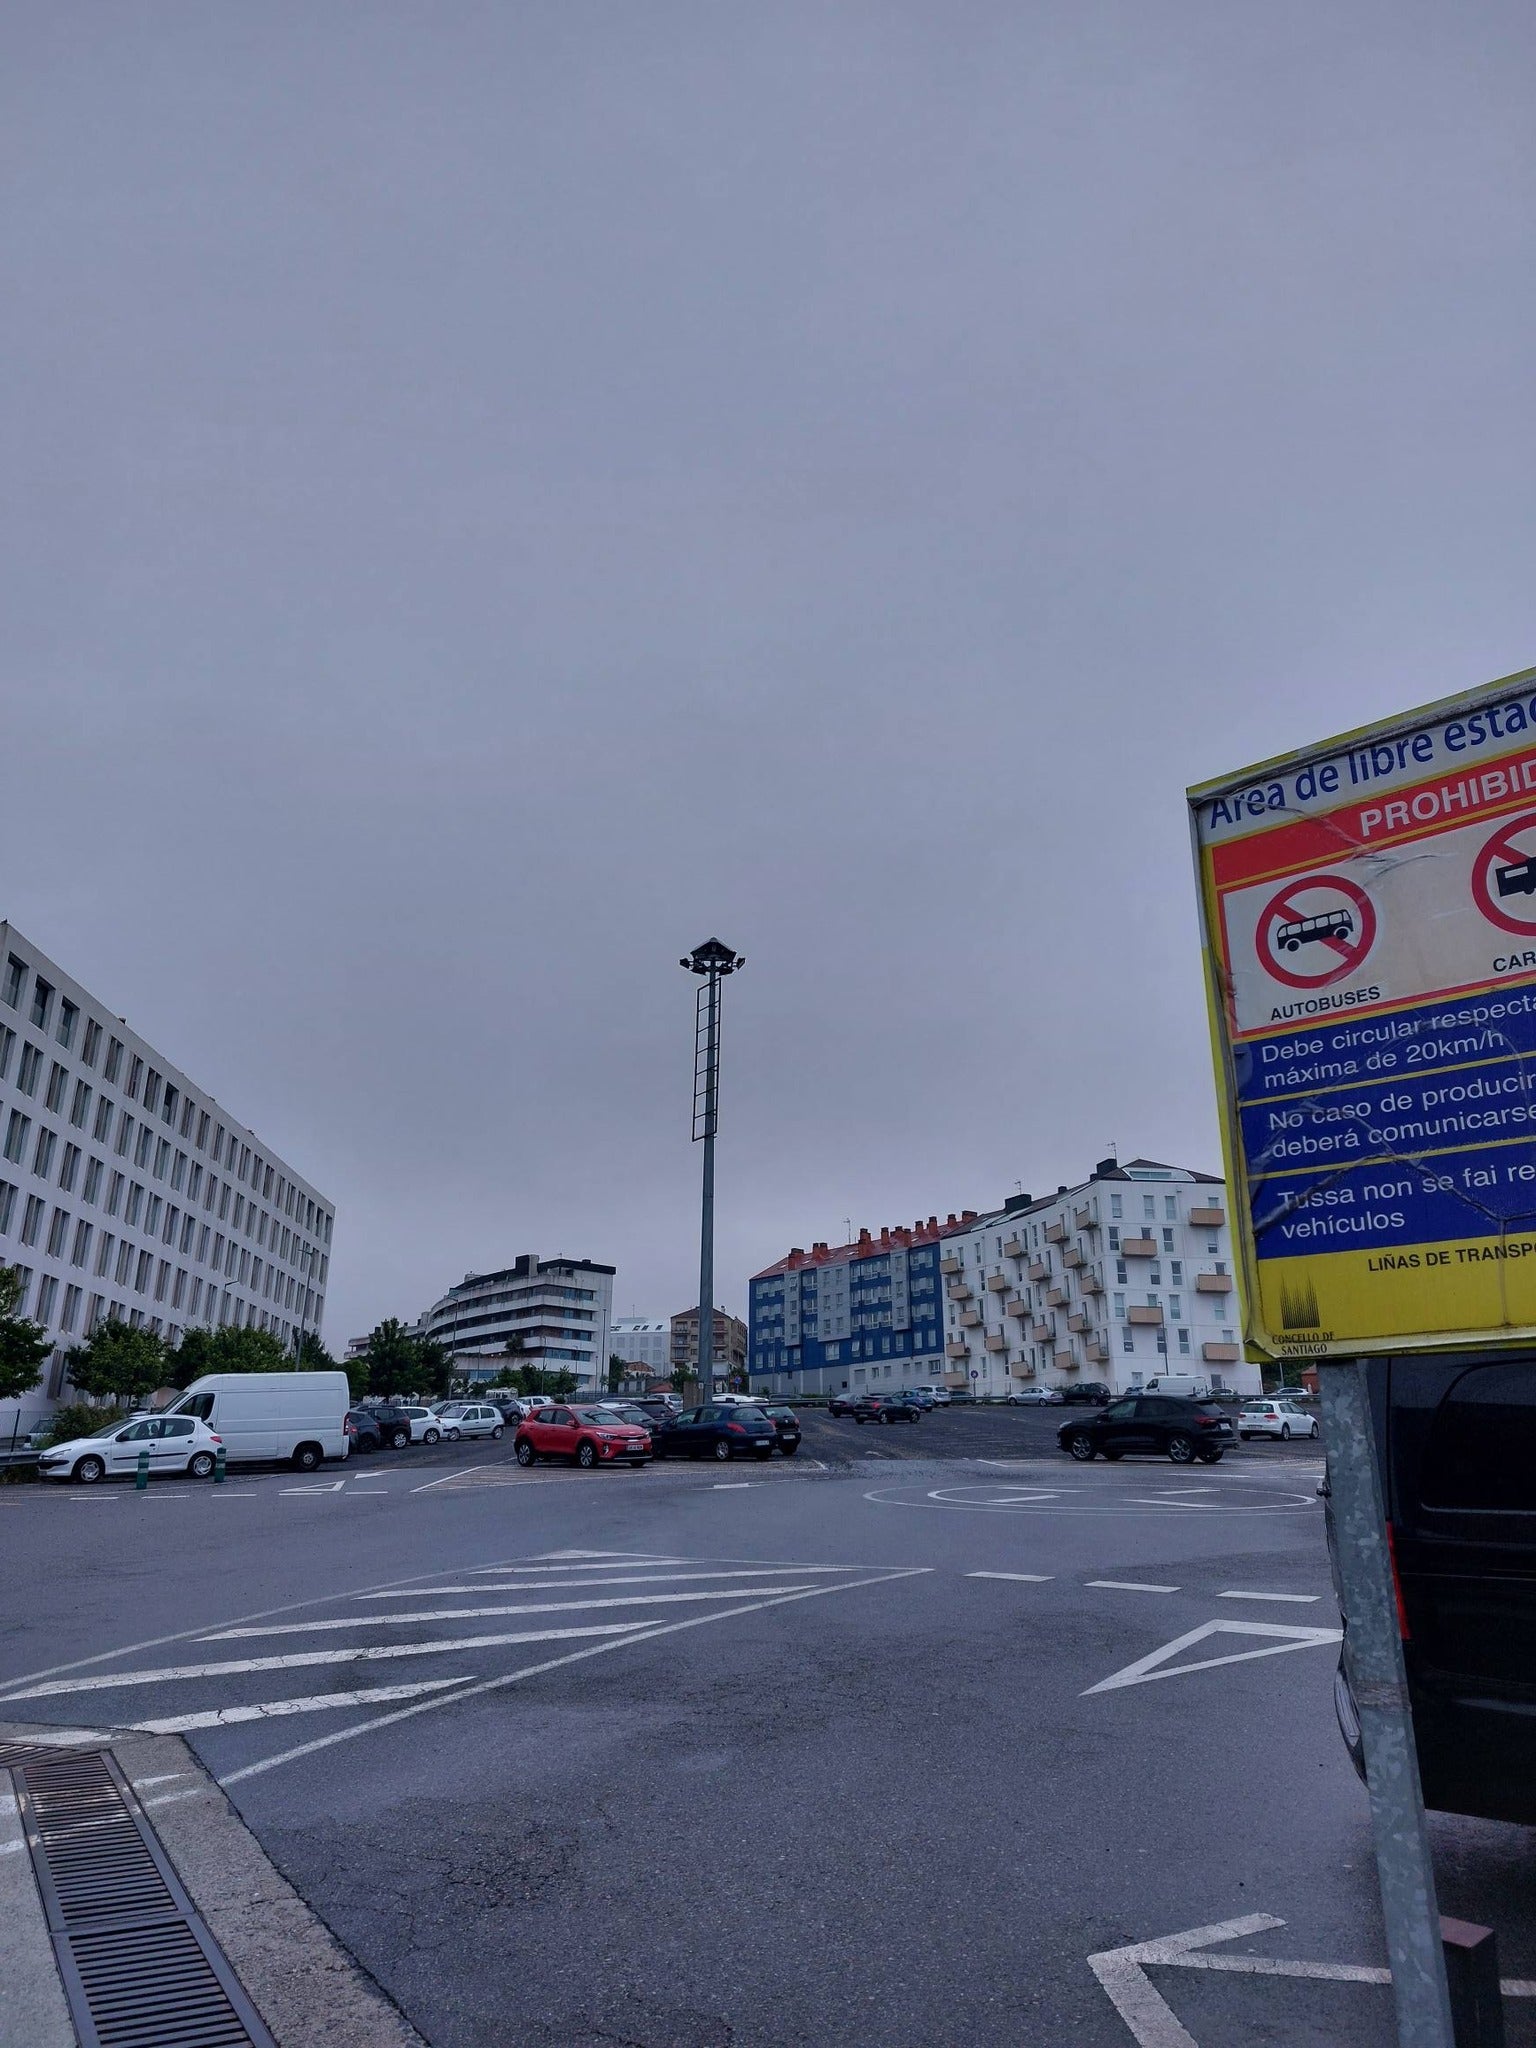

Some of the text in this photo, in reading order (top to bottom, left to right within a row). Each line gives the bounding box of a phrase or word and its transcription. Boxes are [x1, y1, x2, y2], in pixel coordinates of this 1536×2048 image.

[1295, 764, 1339, 800] de
[1349, 733, 1434, 784] libre
[1493, 951, 1536, 972] CAR
[1271, 986, 1380, 1021] AUTOBUSES
[1262, 995, 1536, 1063] Debe circular respect
[1265, 1030, 1504, 1088] máxima de 20km/h
[1269, 1071, 1536, 1130] No caso de producir
[1273, 1128, 1360, 1157] deberá
[1277, 1164, 1536, 1210] Tussa non se fai re
[1282, 1211, 1405, 1239] vehículos
[1368, 1242, 1536, 1271] LIÑAS DE TRANSP
[1272, 1331, 1335, 1344] CONCELLO DE
[1281, 1343, 1328, 1355] SANTIAGO
